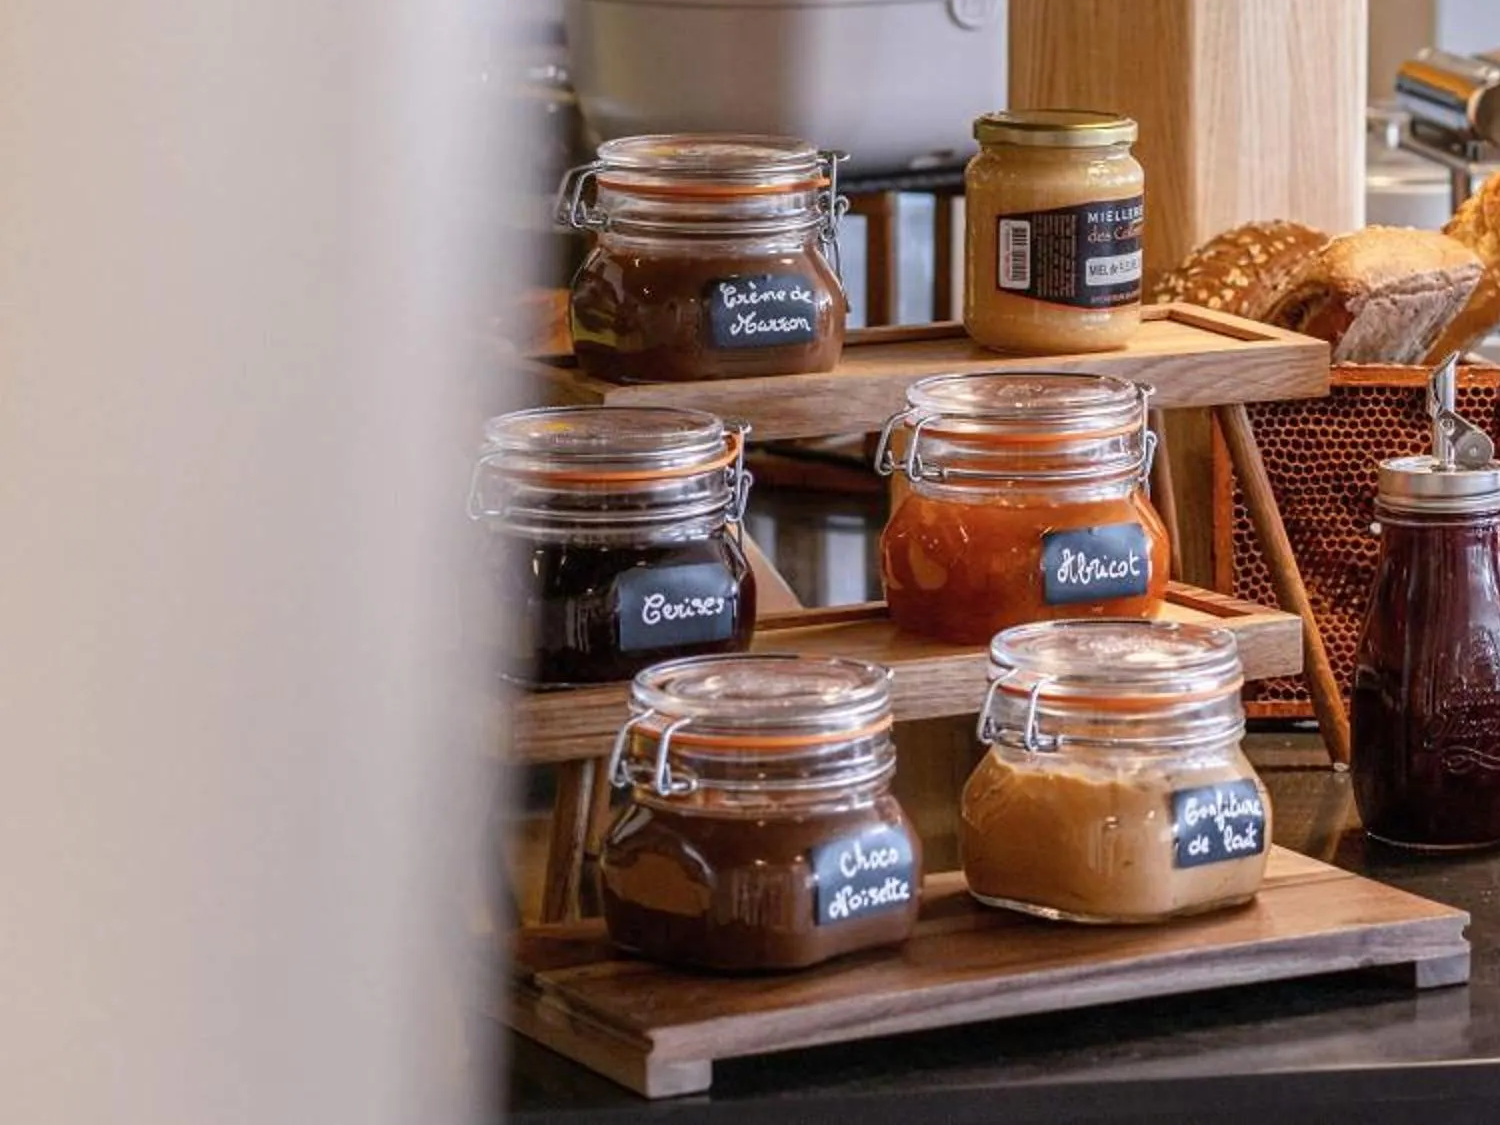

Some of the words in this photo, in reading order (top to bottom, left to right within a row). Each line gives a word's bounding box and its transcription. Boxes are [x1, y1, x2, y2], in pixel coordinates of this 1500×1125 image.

[720, 281, 786, 308] Crème
[789, 285, 812, 303] de
[730, 311, 812, 335] Marron
[1057, 548, 1141, 585] Abricot
[642, 593, 725, 625] Cerises
[1185, 789, 1263, 832] Confiture
[1188, 834, 1209, 855] de
[1223, 822, 1258, 853] lait
[840, 839, 899, 878] Choco
[828, 877, 910, 919] Noisette
